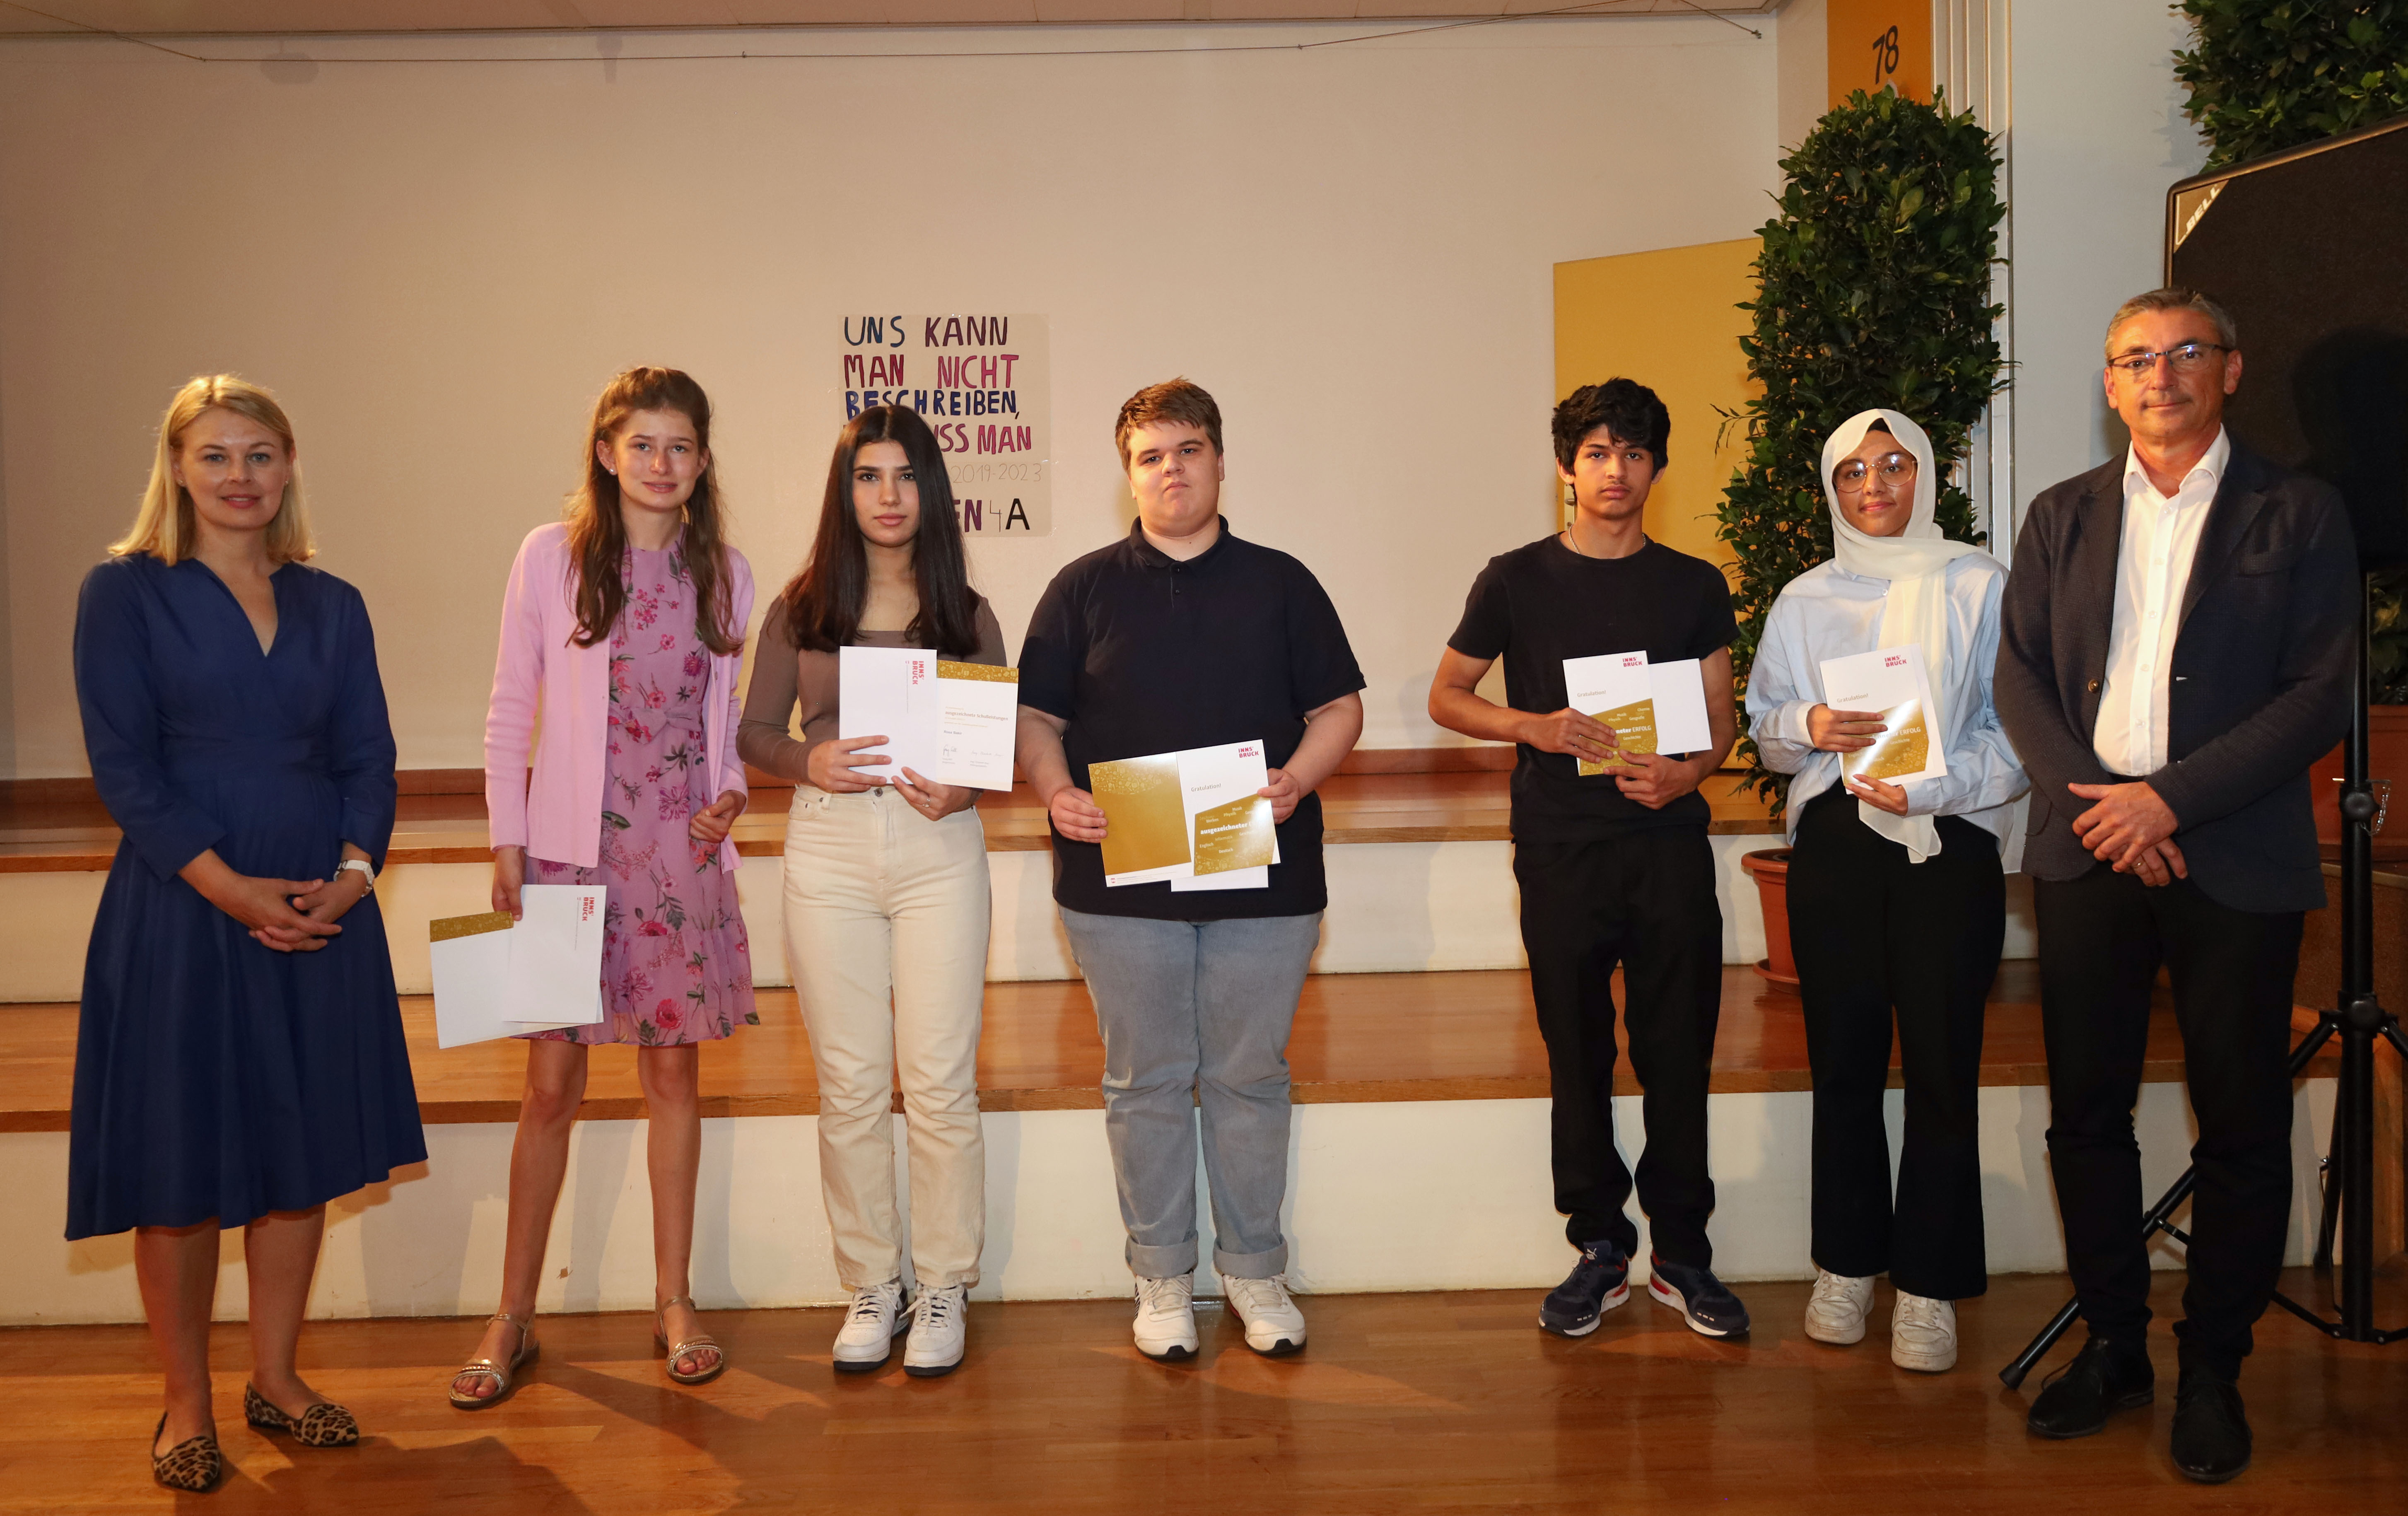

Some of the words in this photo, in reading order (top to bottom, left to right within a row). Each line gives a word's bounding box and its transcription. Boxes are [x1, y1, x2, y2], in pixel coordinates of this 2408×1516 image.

[1872, 25, 1899, 84] 78
[2186, 186, 2220, 233] BELL
[844, 315, 905, 348] UNS
[925, 316, 1008, 347] KANN
[844, 354, 905, 389] MAN
[937, 354, 1020, 389] NICHT
[977, 425, 1032, 455] MAN
[951, 463, 1042, 483] 2019-2023
[1885, 659, 1907, 667] BRUCK
[1836, 693, 1869, 703] Gratulation!
[1899, 727, 1921, 735] ERFOLG
[1191, 783, 1221, 792] Gratulation!
[1200, 822, 1248, 835] ausgezeichneter
